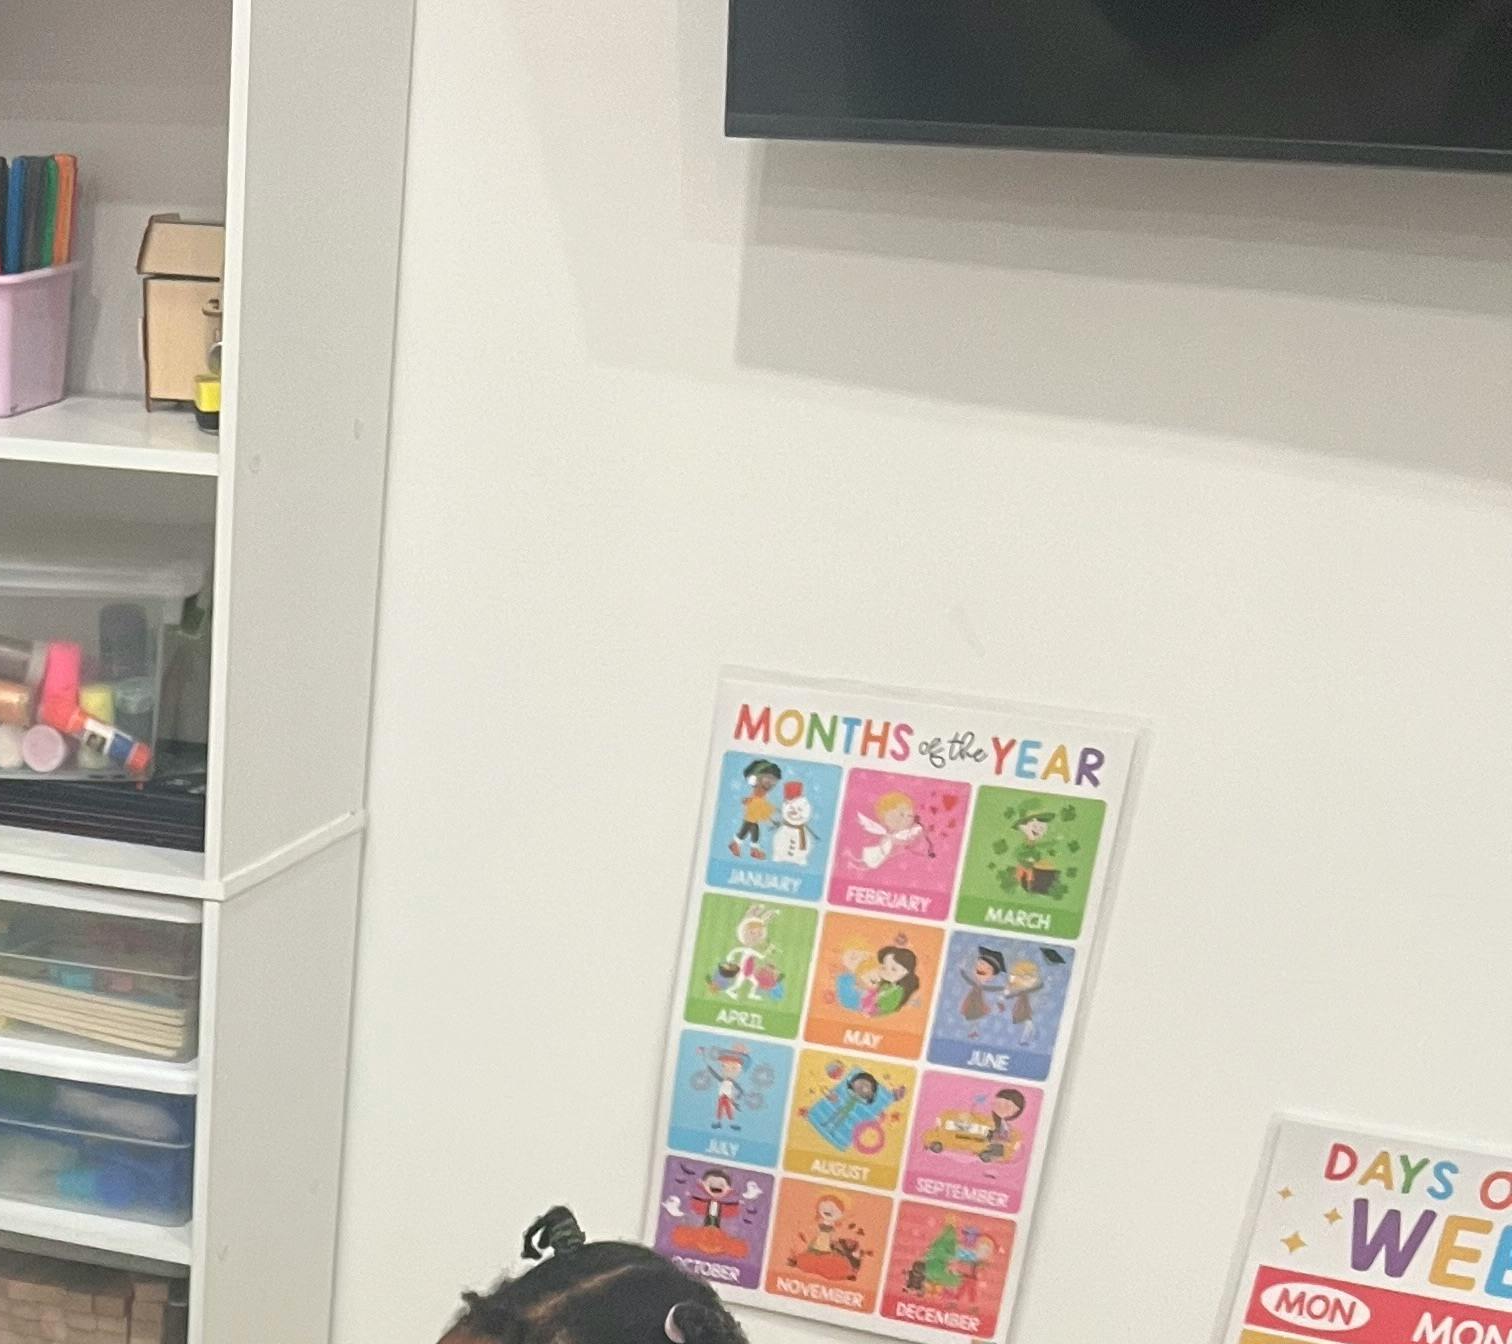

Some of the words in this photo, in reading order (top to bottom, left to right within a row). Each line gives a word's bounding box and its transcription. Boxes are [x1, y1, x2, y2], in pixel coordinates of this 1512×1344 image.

[733, 703, 915, 762] MONTHS
[918, 737, 946, 769] of
[947, 731, 989, 763] the
[991, 736, 1106, 788] YEAR
[727, 868, 803, 894] JANUARY
[846, 885, 933, 913] FEBRUARY
[984, 906, 1052, 931] MARCH
[716, 1007, 766, 1031] APRIL
[843, 1028, 884, 1049] MAY
[966, 1049, 1012, 1071] JUNE
[706, 1138, 740, 1158] JULY
[810, 1158, 872, 1182] AUGUST
[1324, 1142, 1459, 1201] DAYS
[914, 1176, 1010, 1208] SEPTEMBER
[672, 1256, 740, 1282] OCTOBER
[776, 1276, 865, 1308] NOVEMBER
[895, 1301, 982, 1333] DECEMBER
[1274, 1288, 1357, 1326] MON
